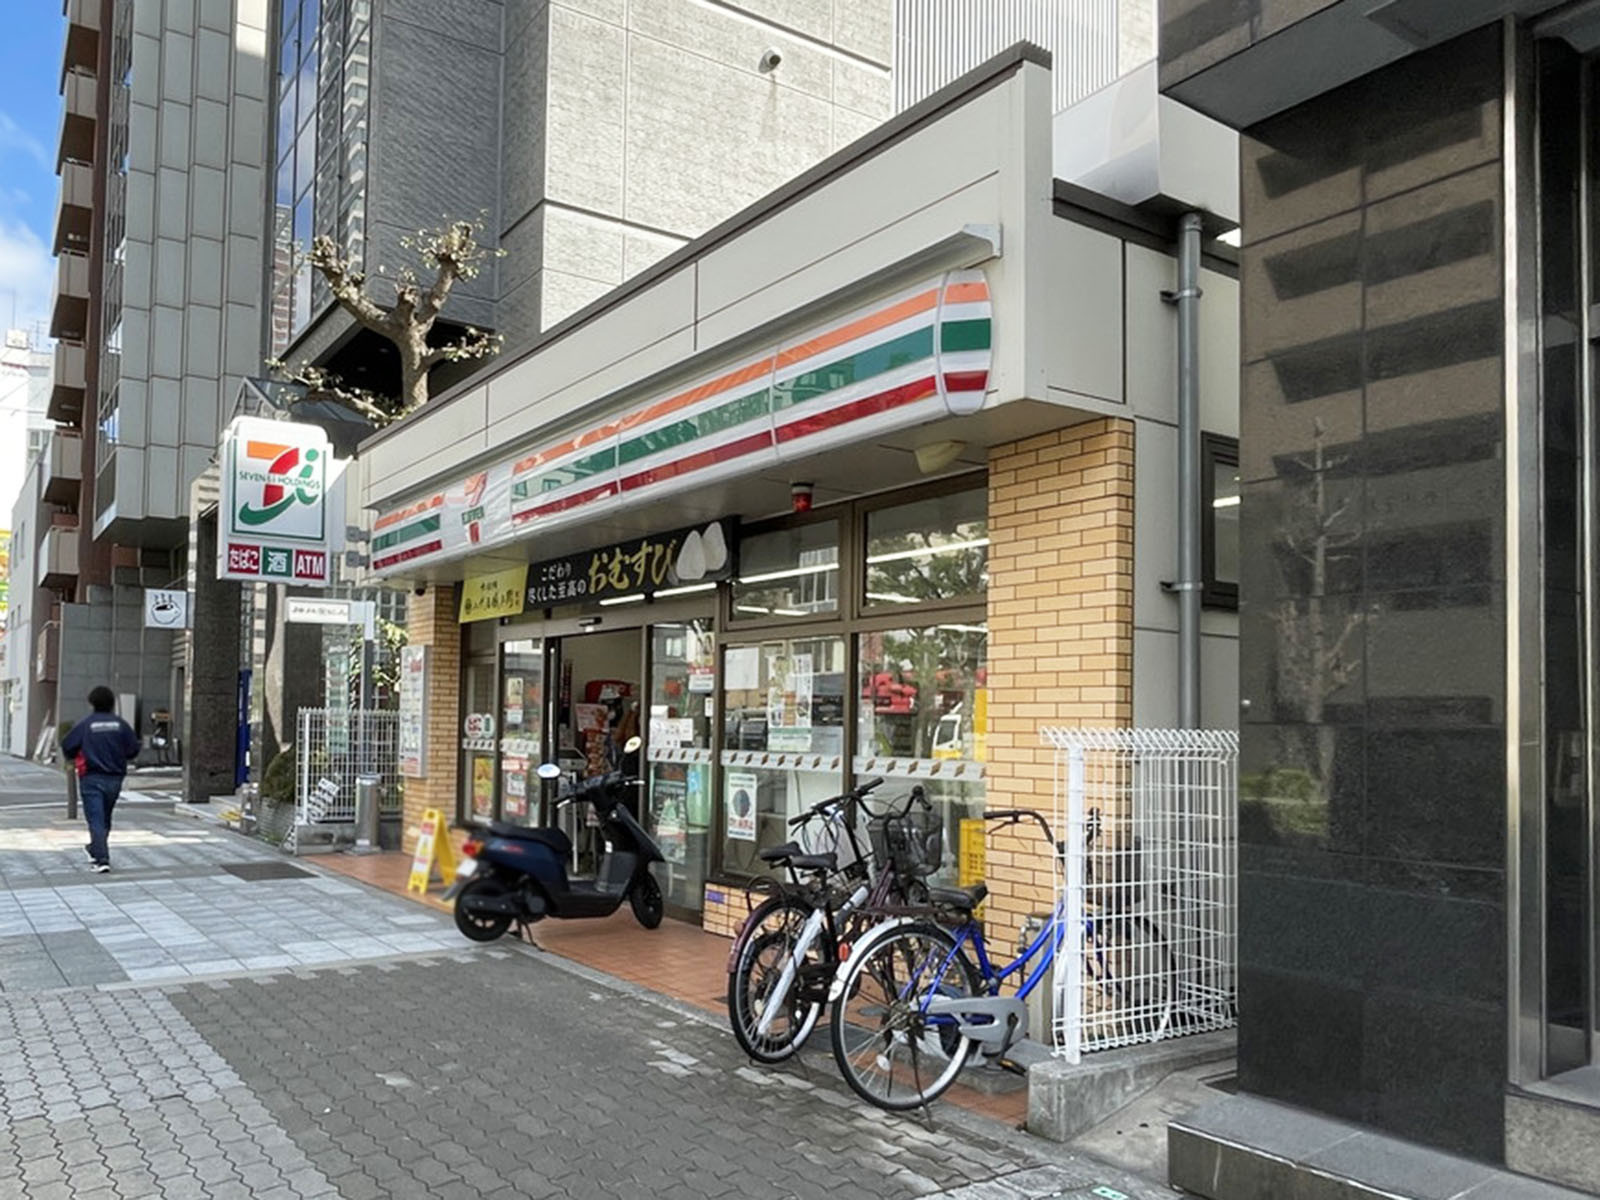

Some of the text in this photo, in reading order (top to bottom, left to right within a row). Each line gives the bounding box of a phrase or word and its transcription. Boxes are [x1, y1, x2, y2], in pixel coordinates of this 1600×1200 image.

[229, 548, 259, 571] たばこ
[267, 551, 288, 573] 酒
[296, 555, 324, 576] ATM
[588, 539, 677, 595] おむすび
[541, 562, 572, 581] こだわり
